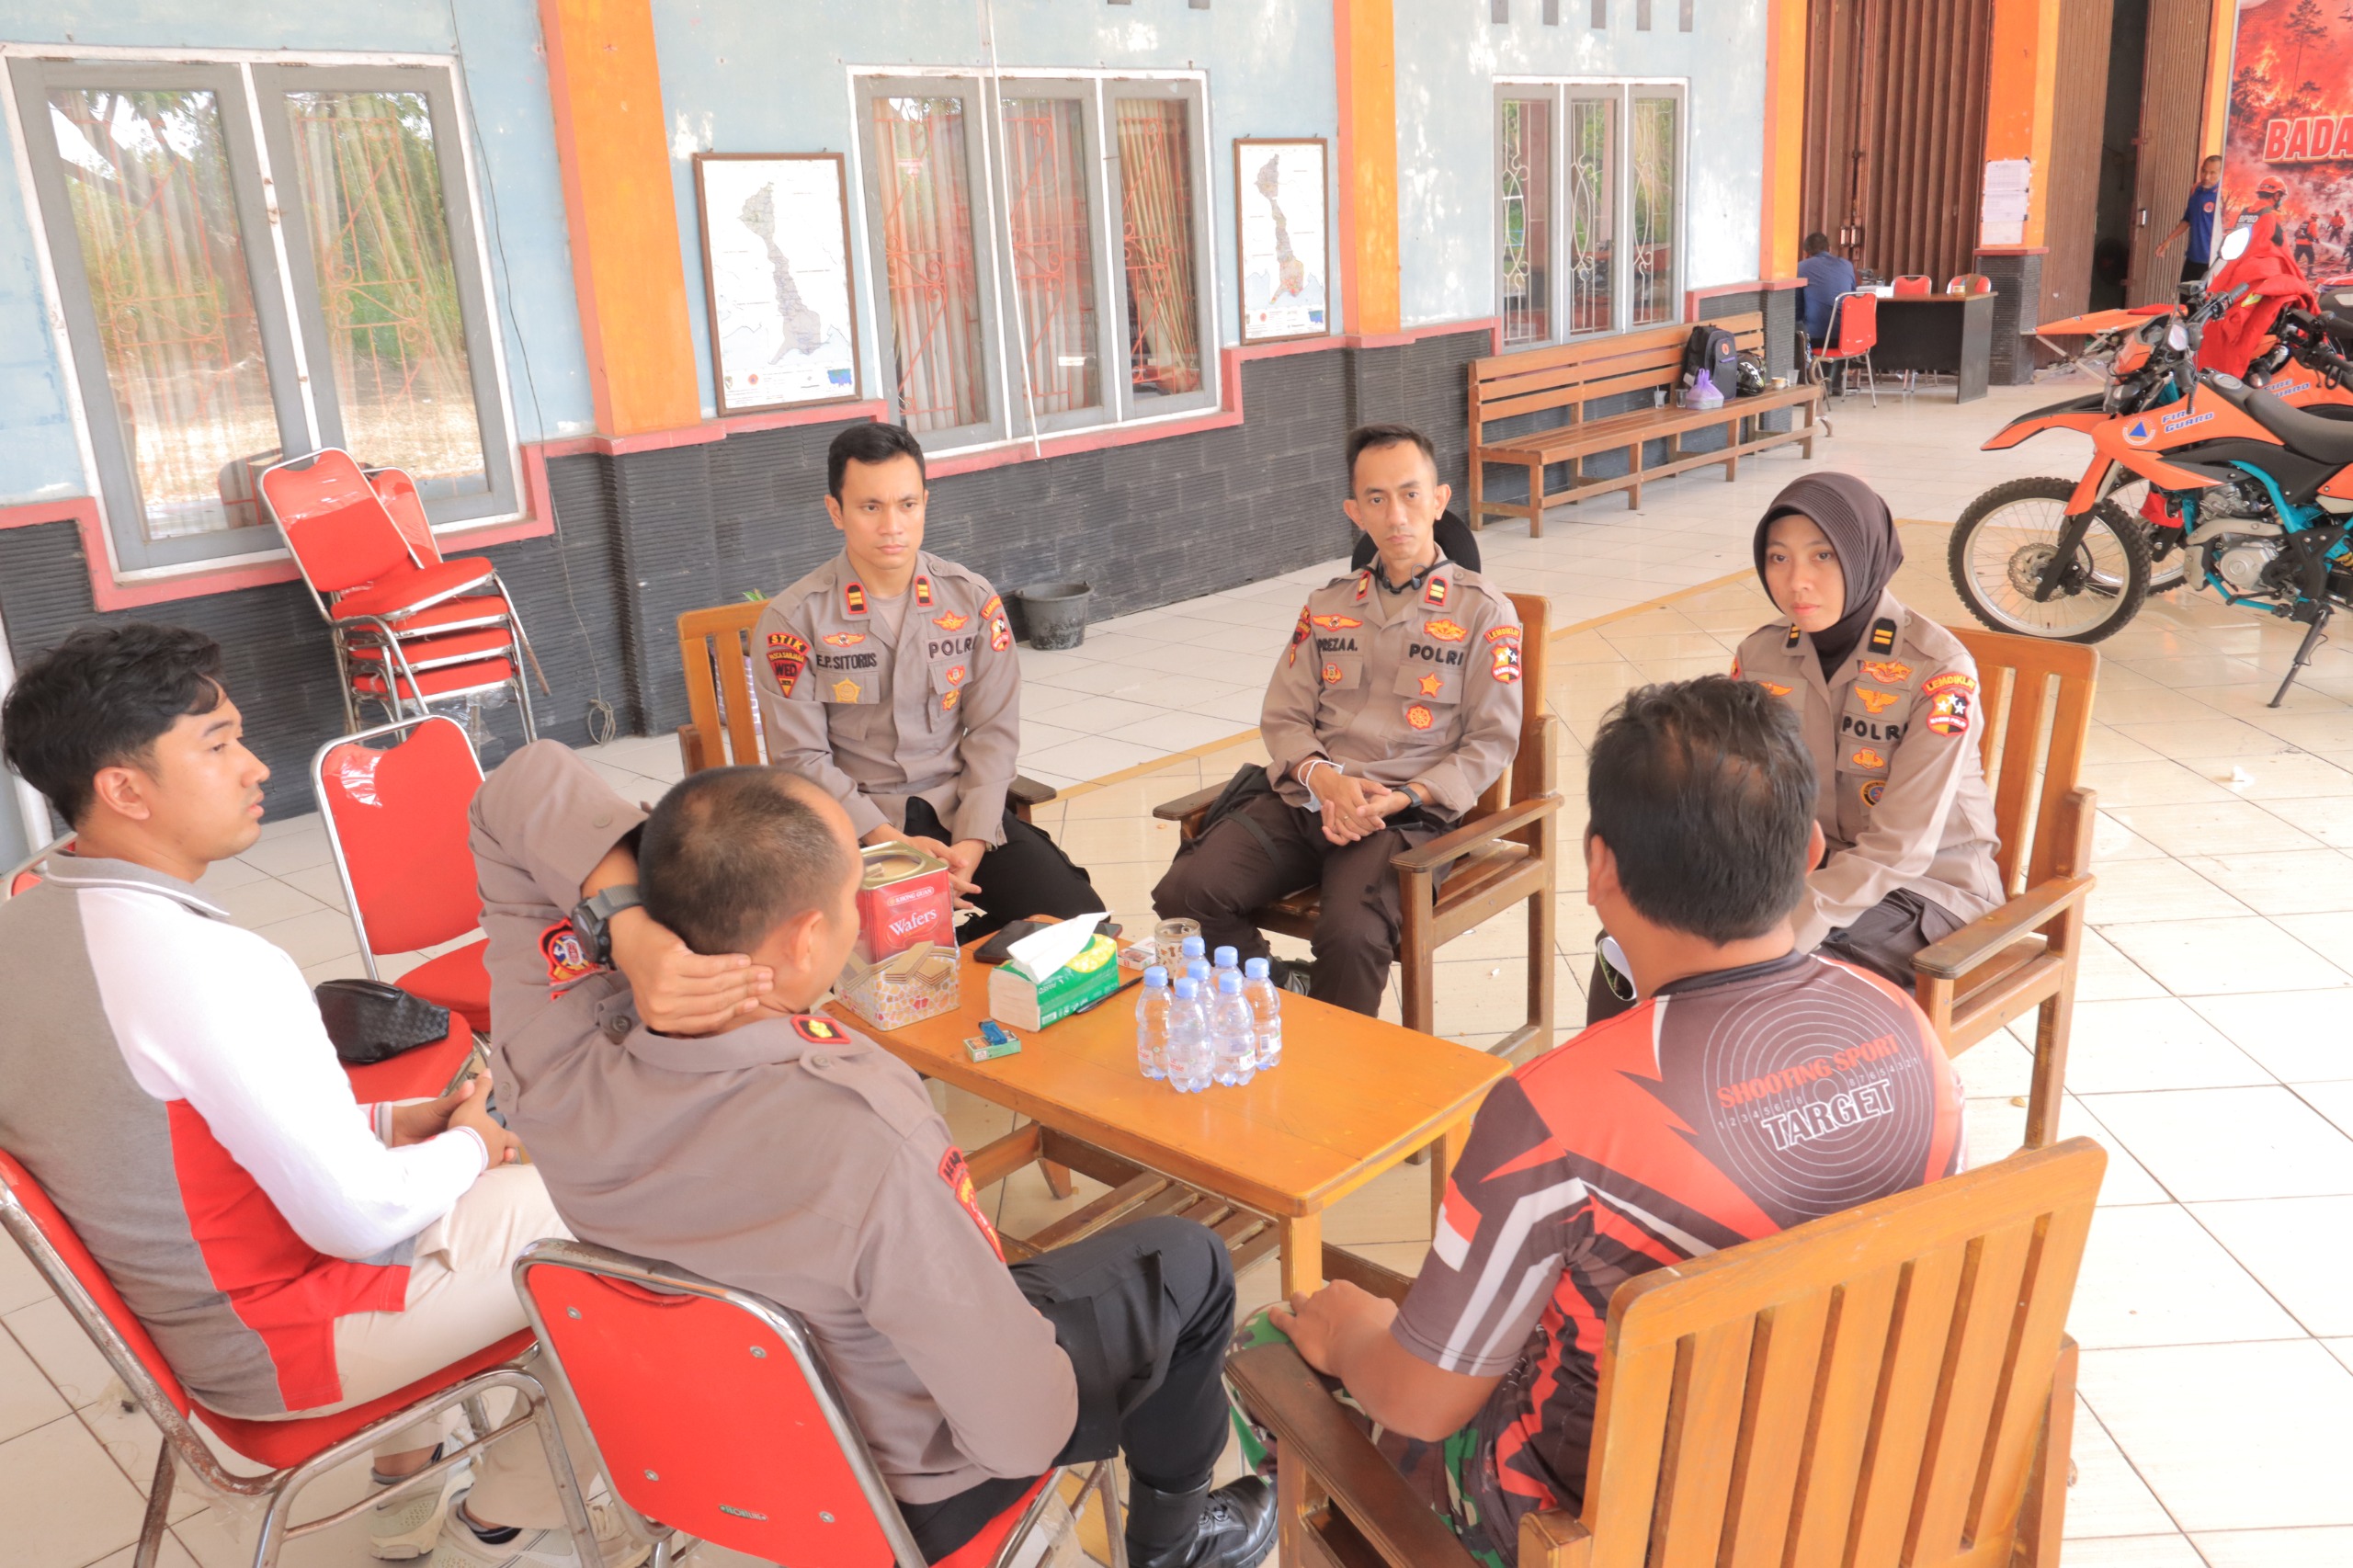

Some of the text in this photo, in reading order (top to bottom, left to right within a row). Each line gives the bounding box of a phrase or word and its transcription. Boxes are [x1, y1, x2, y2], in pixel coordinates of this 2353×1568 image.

[2263, 115, 2353, 161] BADA
[2237, 214, 2259, 223] BPBD
[2164, 412, 2214, 434] GUARD
[770, 634, 804, 651] STIK
[1408, 643, 1463, 666] POLRI
[774, 662, 798, 677] WED
[889, 909, 938, 937] Wafers
[1716, 1033, 1899, 1108] SHOOTING SPORT
[1761, 1078, 1894, 1151] TARGET
